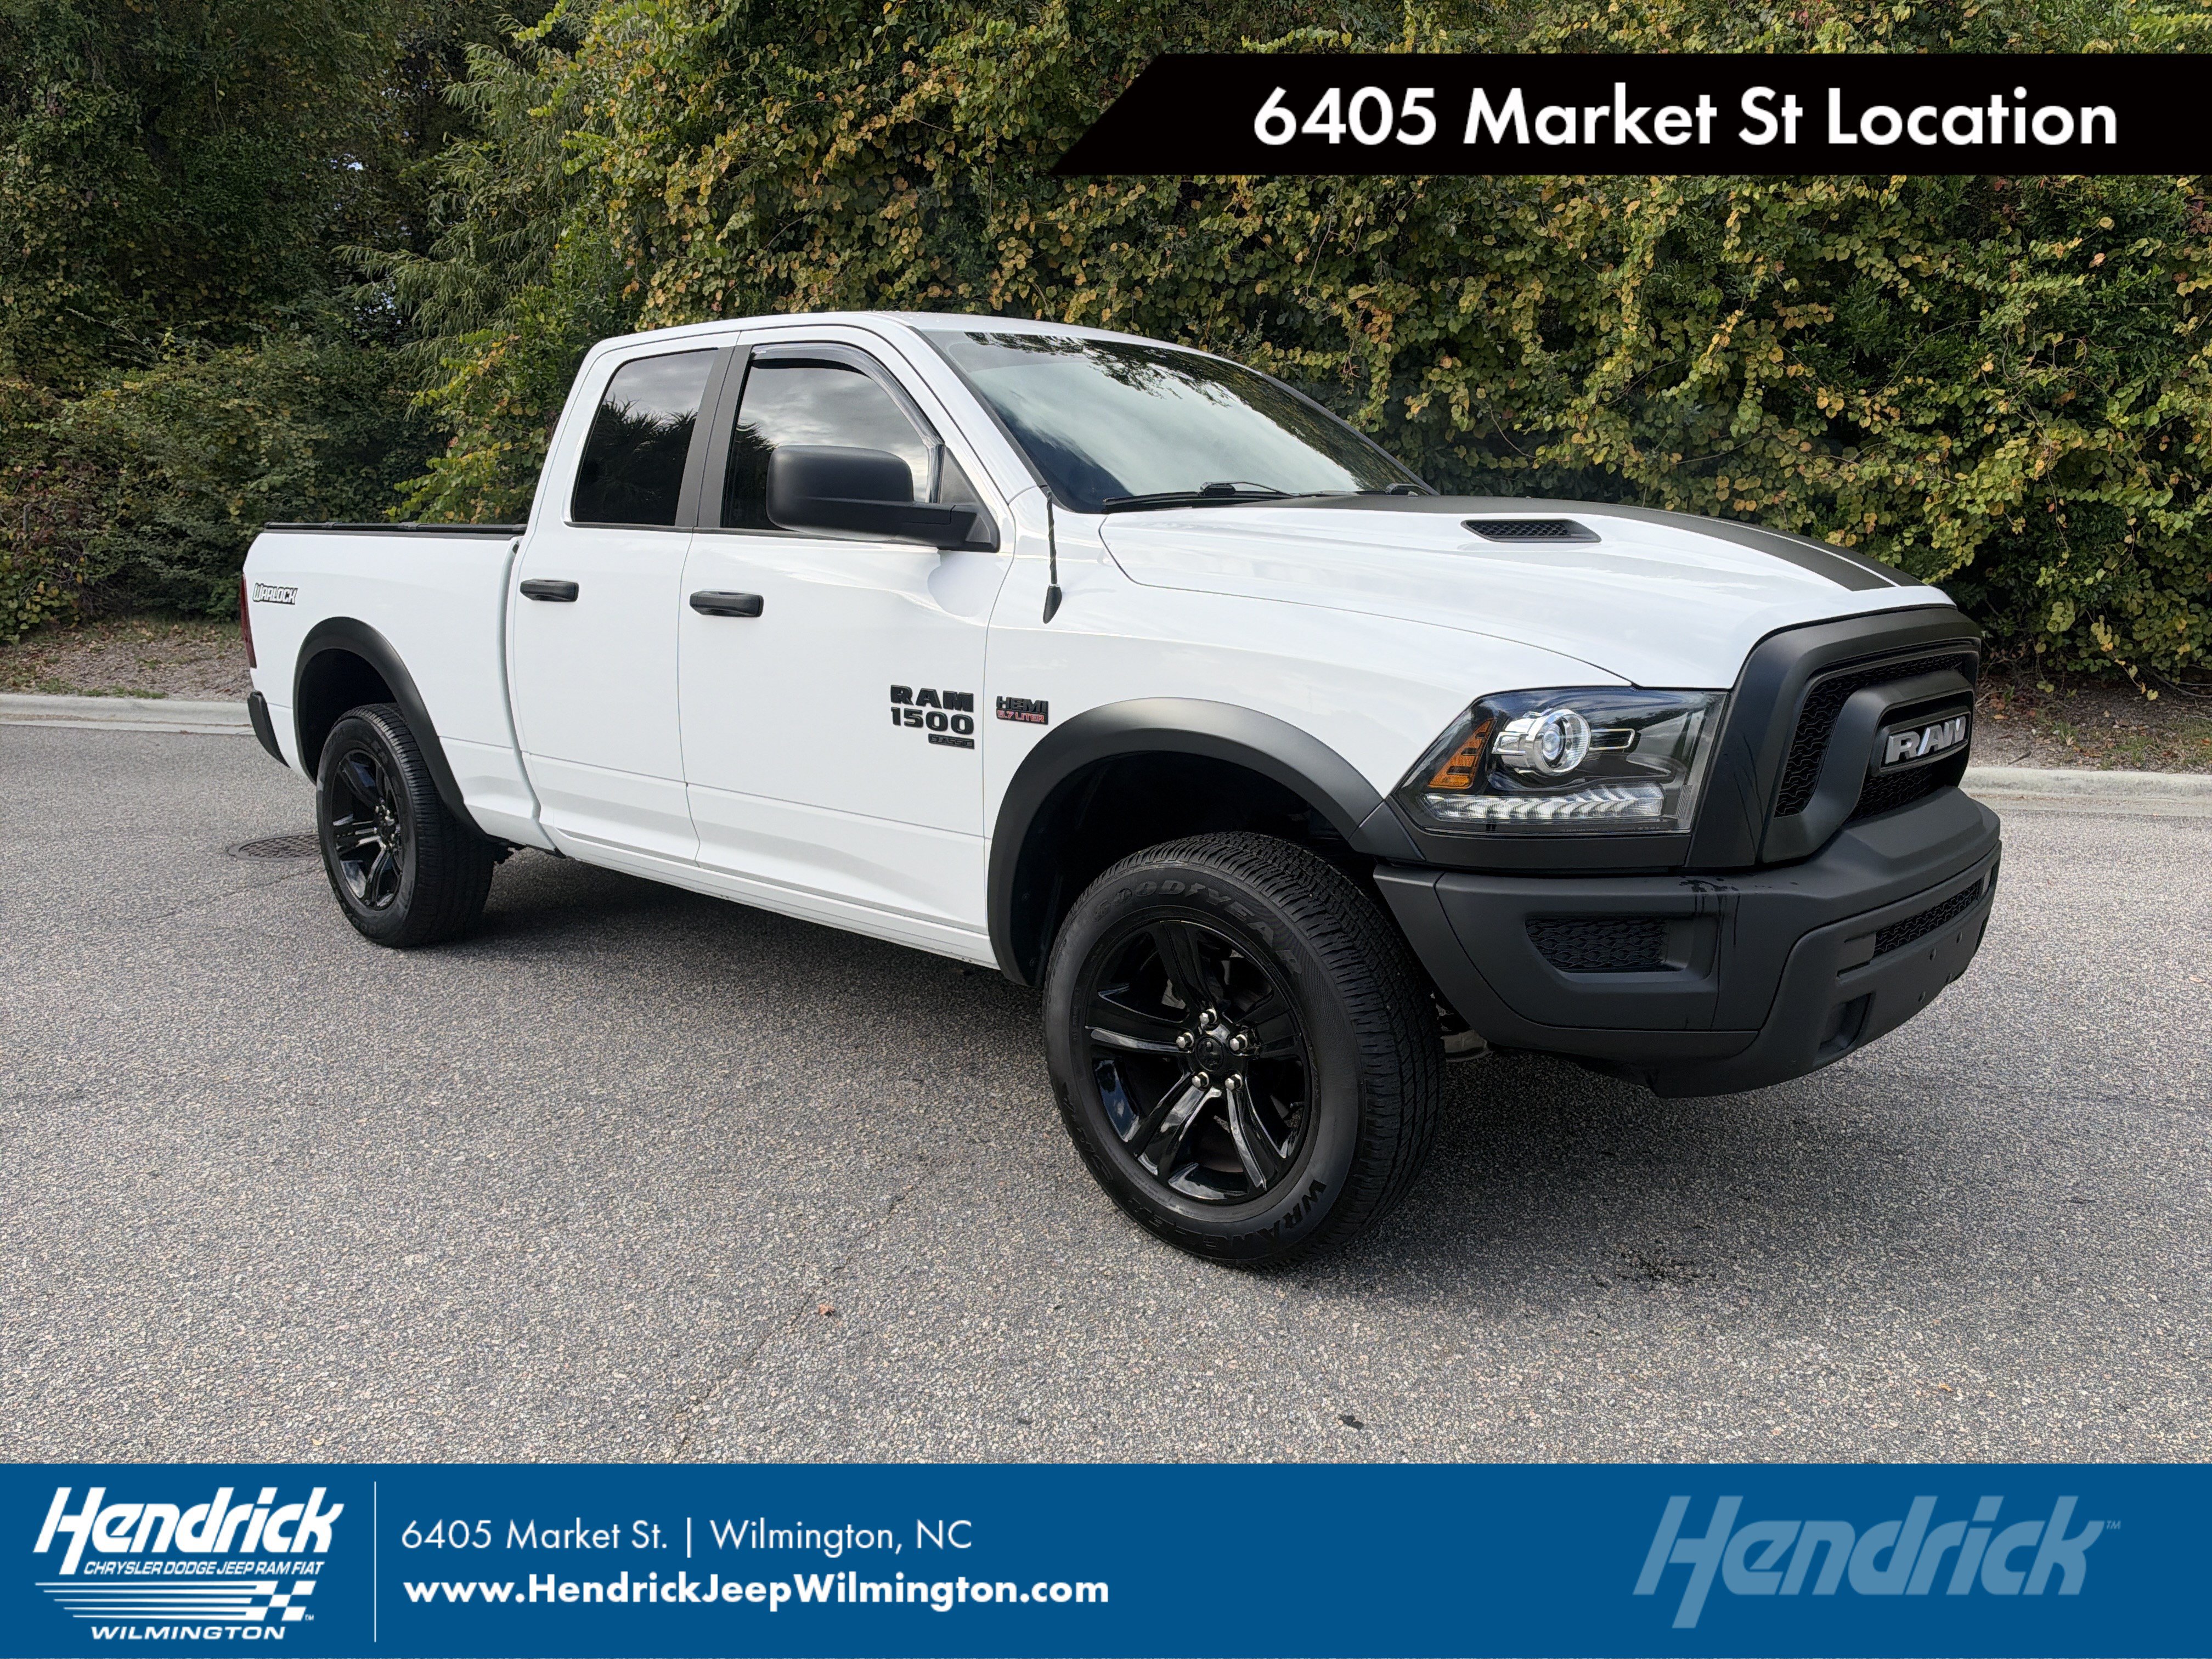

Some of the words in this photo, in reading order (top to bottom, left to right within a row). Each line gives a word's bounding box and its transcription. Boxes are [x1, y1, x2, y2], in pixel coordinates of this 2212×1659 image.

[253, 582, 298, 605] WARLOCK
[890, 684, 974, 713] RAM
[996, 696, 1048, 713] HEMI
[891, 707, 974, 735] 1500
[997, 709, 1014, 719] 5.7
[1015, 712, 1045, 723] LITER
[1885, 715, 1966, 764] RAM
[1094, 879, 1303, 975] GOODYEAR
